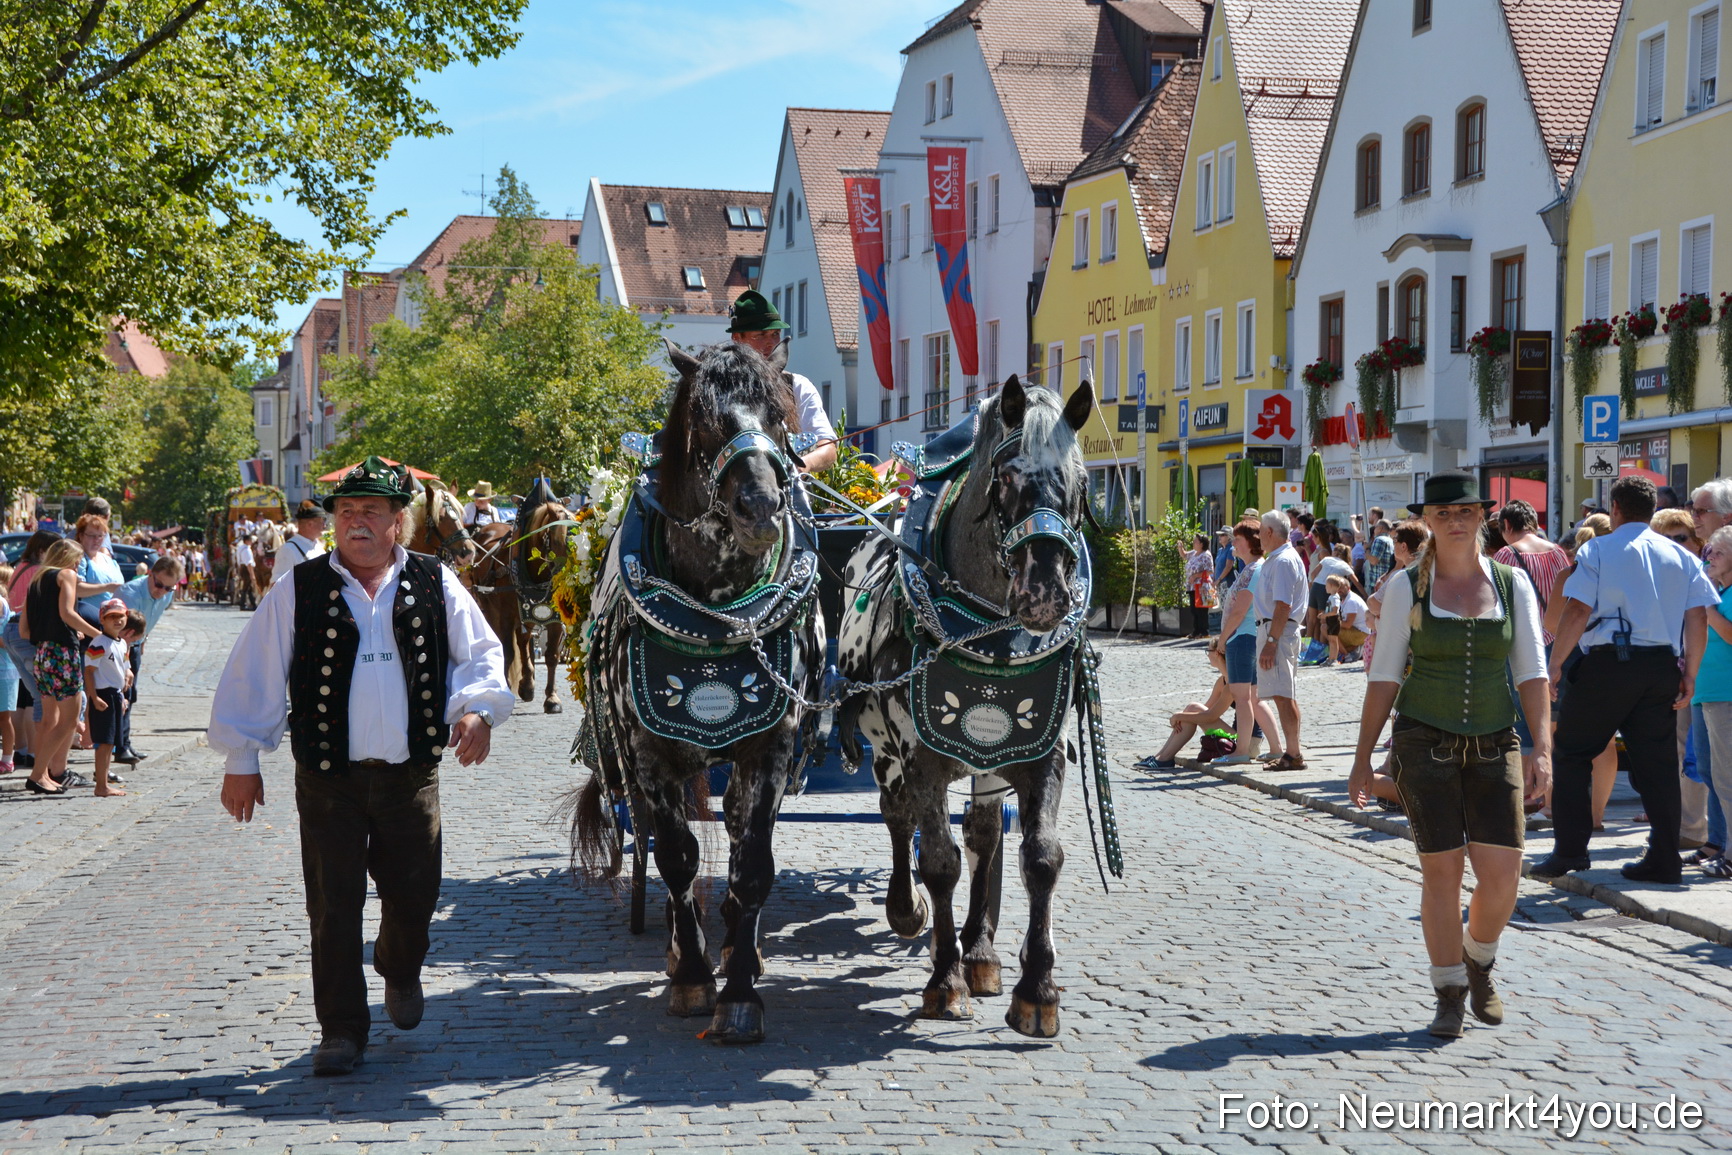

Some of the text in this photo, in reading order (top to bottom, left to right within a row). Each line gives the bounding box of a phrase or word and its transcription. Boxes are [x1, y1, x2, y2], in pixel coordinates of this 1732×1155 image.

[934, 155, 952, 210] K&L
[952, 155, 960, 210] RUPPERT
[1087, 290, 1158, 327] HOTEL Lehmeier
[1138, 377, 1145, 406] P
[1635, 375, 1656, 391] WOLLE
[1180, 404, 1187, 434] P
[1192, 407, 1221, 427] TAIFUN
[1591, 401, 1612, 438] P
[1083, 435, 1124, 455] Restaurant
[1618, 442, 1641, 459] WOLLE
[1326, 466, 1345, 476] APOTHEKE
[1385, 460, 1406, 471] APOTHEKE
[108, 652, 115, 662] 4
[696, 704, 729, 712] Weismann
[970, 714, 1006, 725] Holzrückerei
[970, 724, 1002, 735] Weismann
